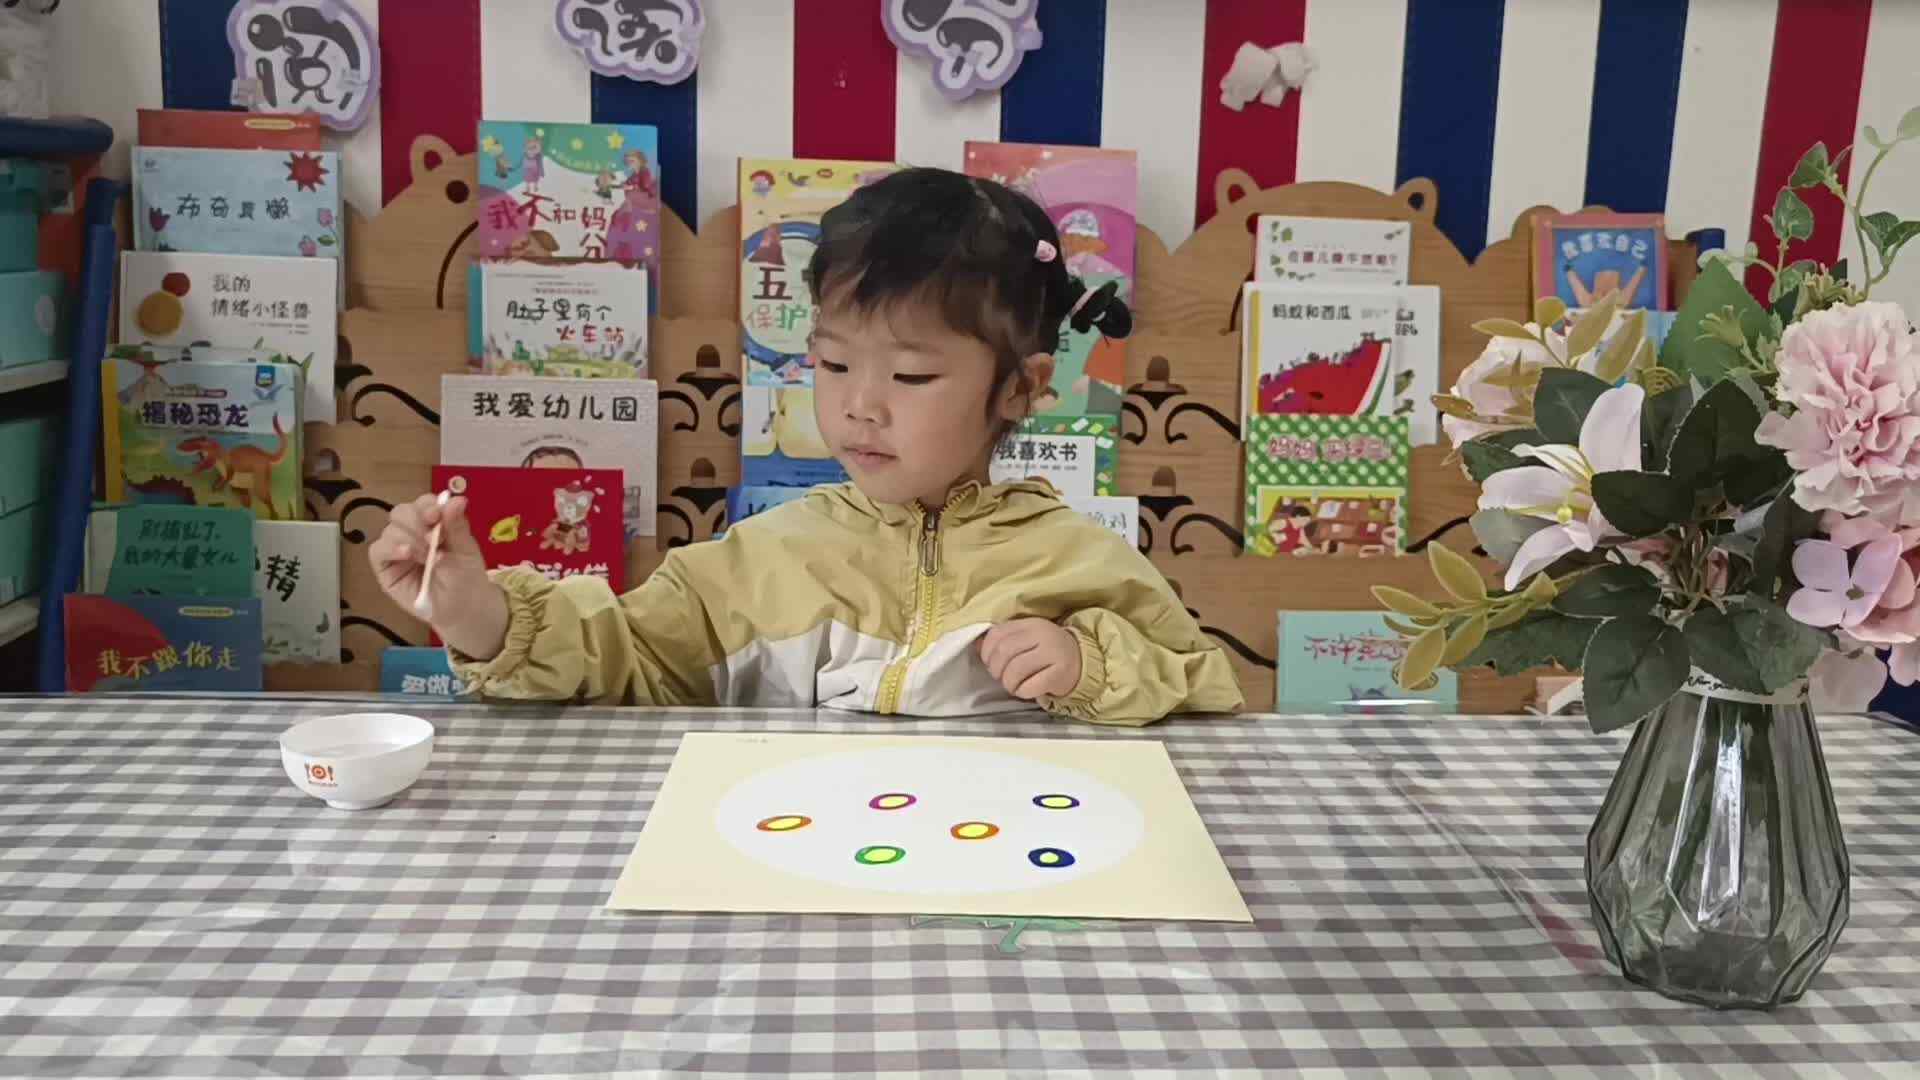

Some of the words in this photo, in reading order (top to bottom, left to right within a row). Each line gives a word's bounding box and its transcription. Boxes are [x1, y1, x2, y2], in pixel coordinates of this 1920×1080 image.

[1562, 232, 1648, 260] 我喜欢自己
[212, 274, 251, 294] 我的
[752, 267, 792, 301] 五
[209, 299, 310, 321] 情绪小怪兽
[506, 298, 613, 322] 肚子里有个
[1272, 304, 1351, 321] 蚂蚁和西瓜
[143, 401, 249, 427] 揭秘恐龙
[473, 391, 638, 422] 我爱幼儿园
[995, 439, 1078, 462] 我喜欢书
[254, 548, 302, 603] 精
[98, 639, 241, 681] 我不跟你走
